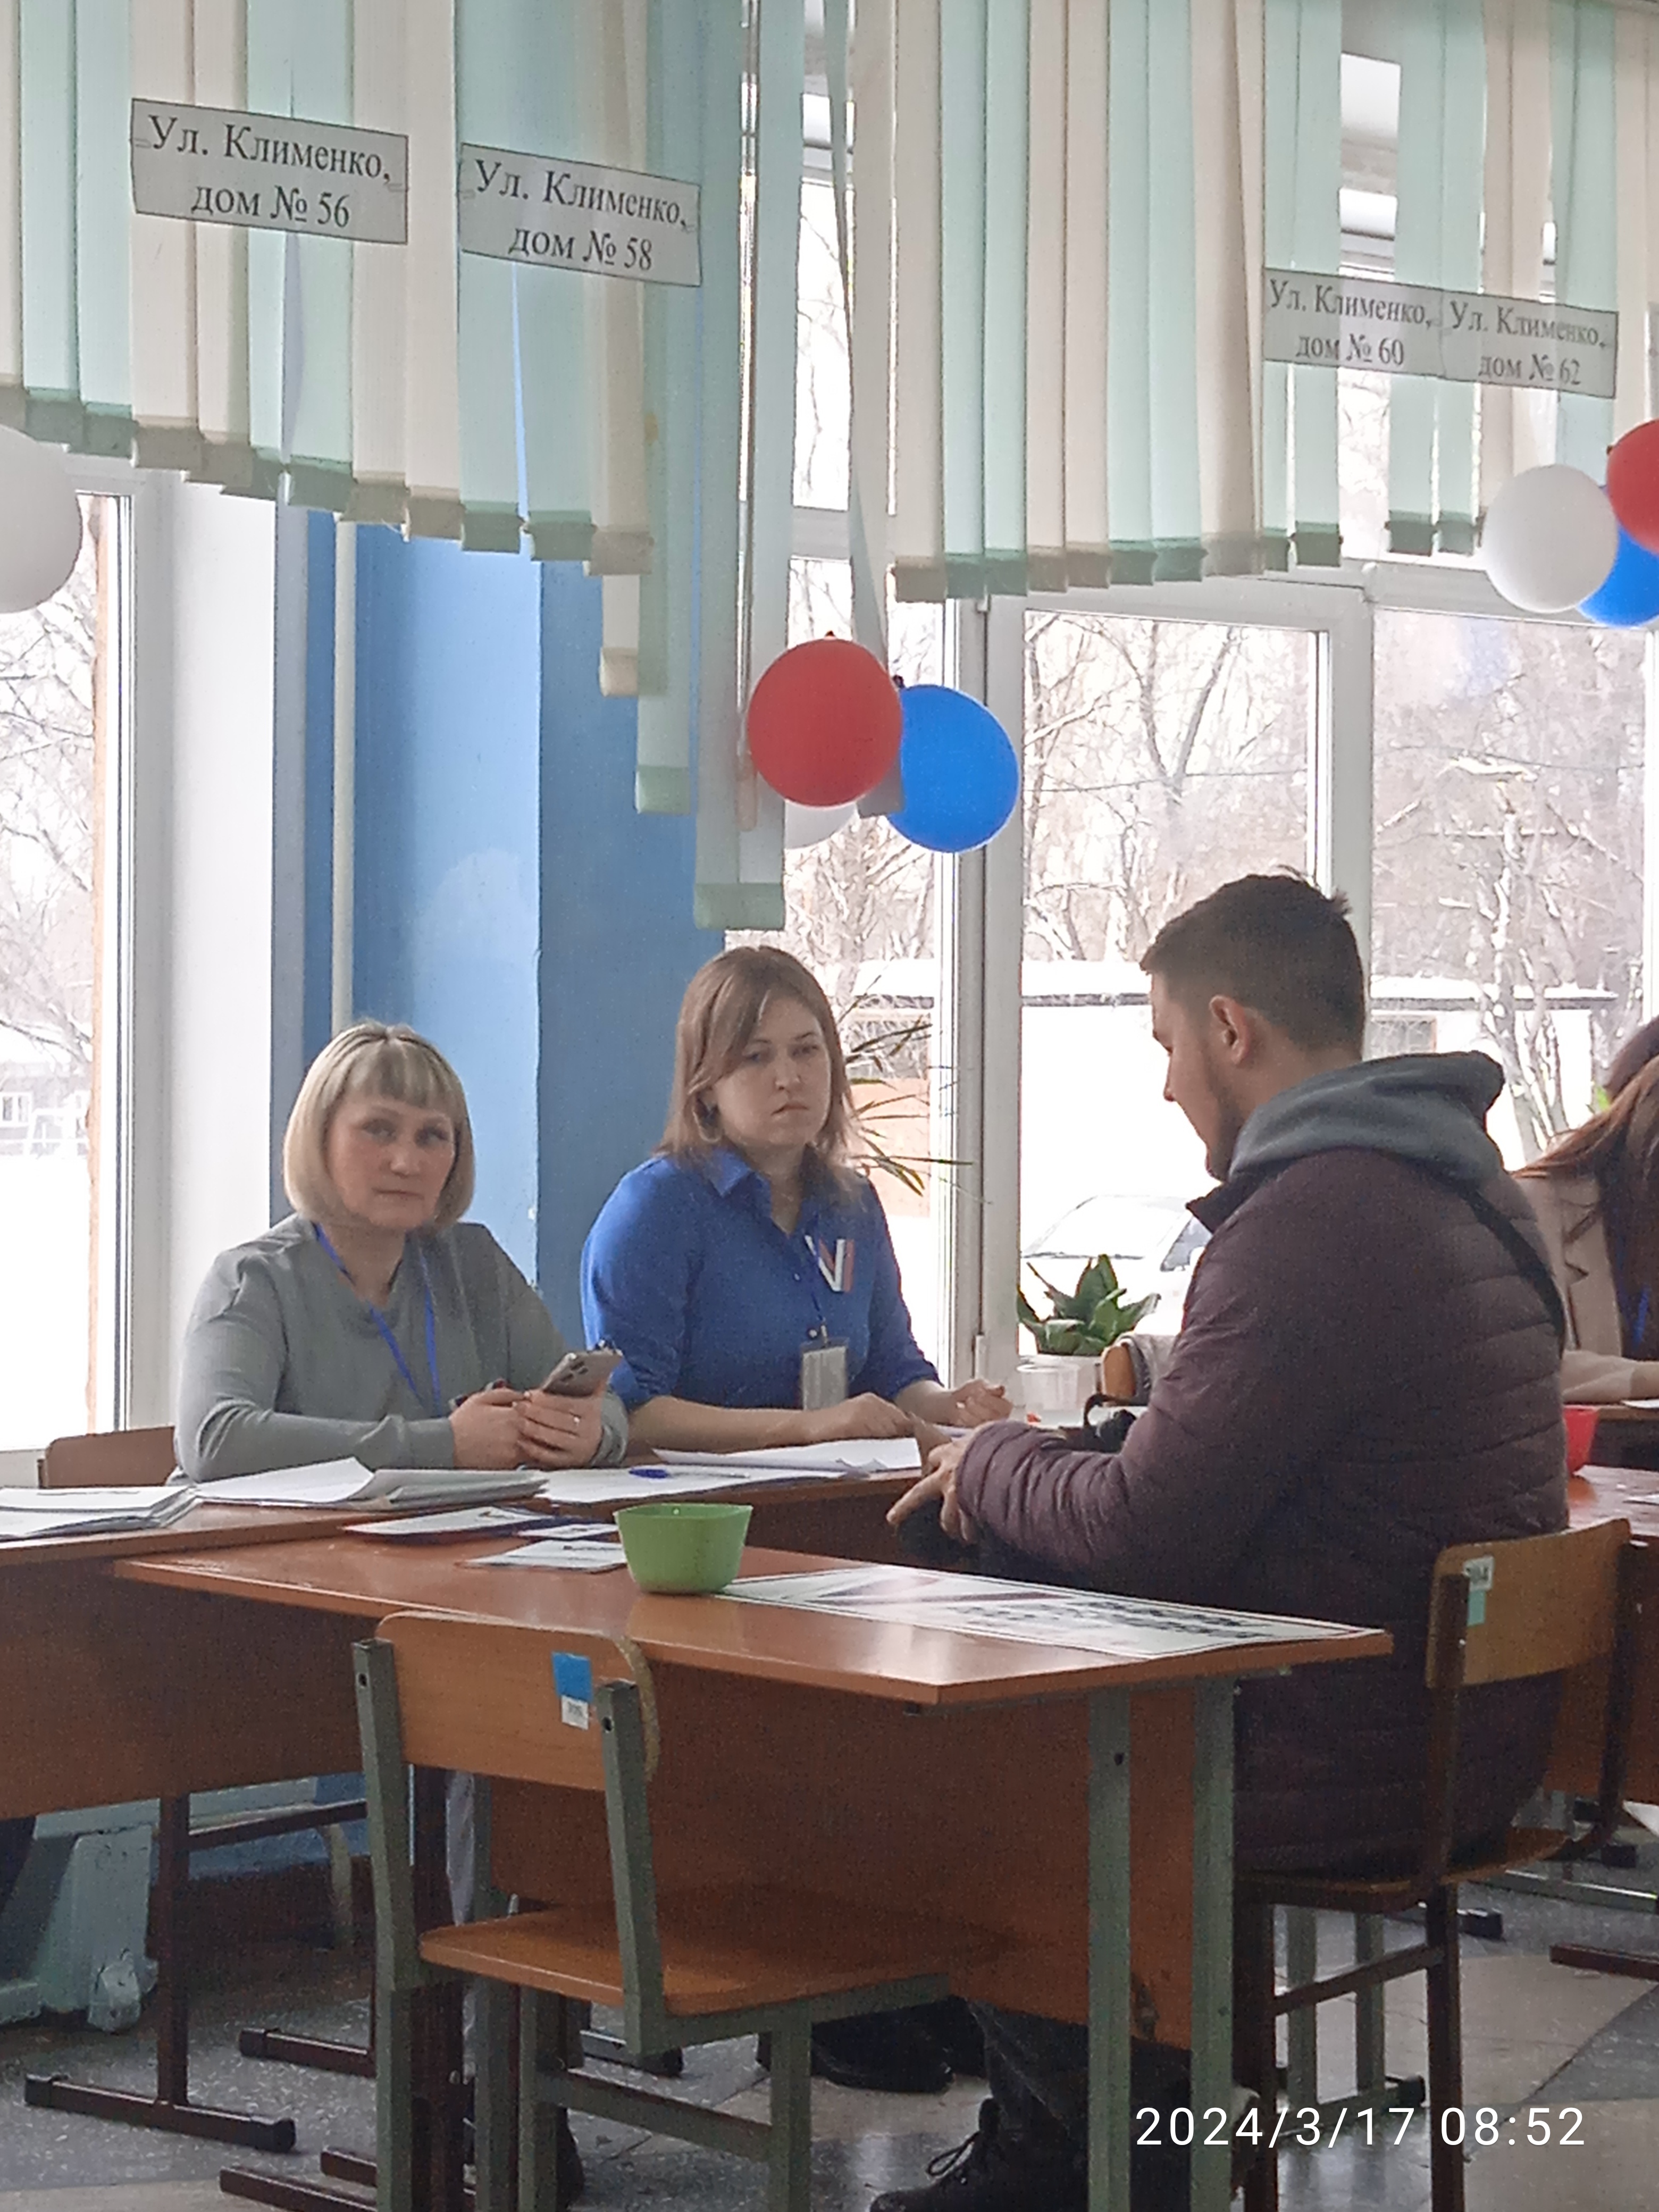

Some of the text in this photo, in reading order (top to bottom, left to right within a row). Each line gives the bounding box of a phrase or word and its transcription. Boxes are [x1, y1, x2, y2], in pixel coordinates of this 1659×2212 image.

[148, 115, 391, 185] Ул. Клименко,
[191, 185, 349, 228] дом № 56
[474, 160, 687, 229] Ул. Клименко,
[509, 227, 652, 271] дом № 58
[1270, 280, 1431, 329] Ул. Клименко,
[1450, 300, 1606, 348] Ул. Клименко,
[1296, 335, 1339, 359] дом
[1378, 339, 1404, 365] 60
[1478, 355, 1521, 379] дом
[1559, 359, 1581, 386] 62
